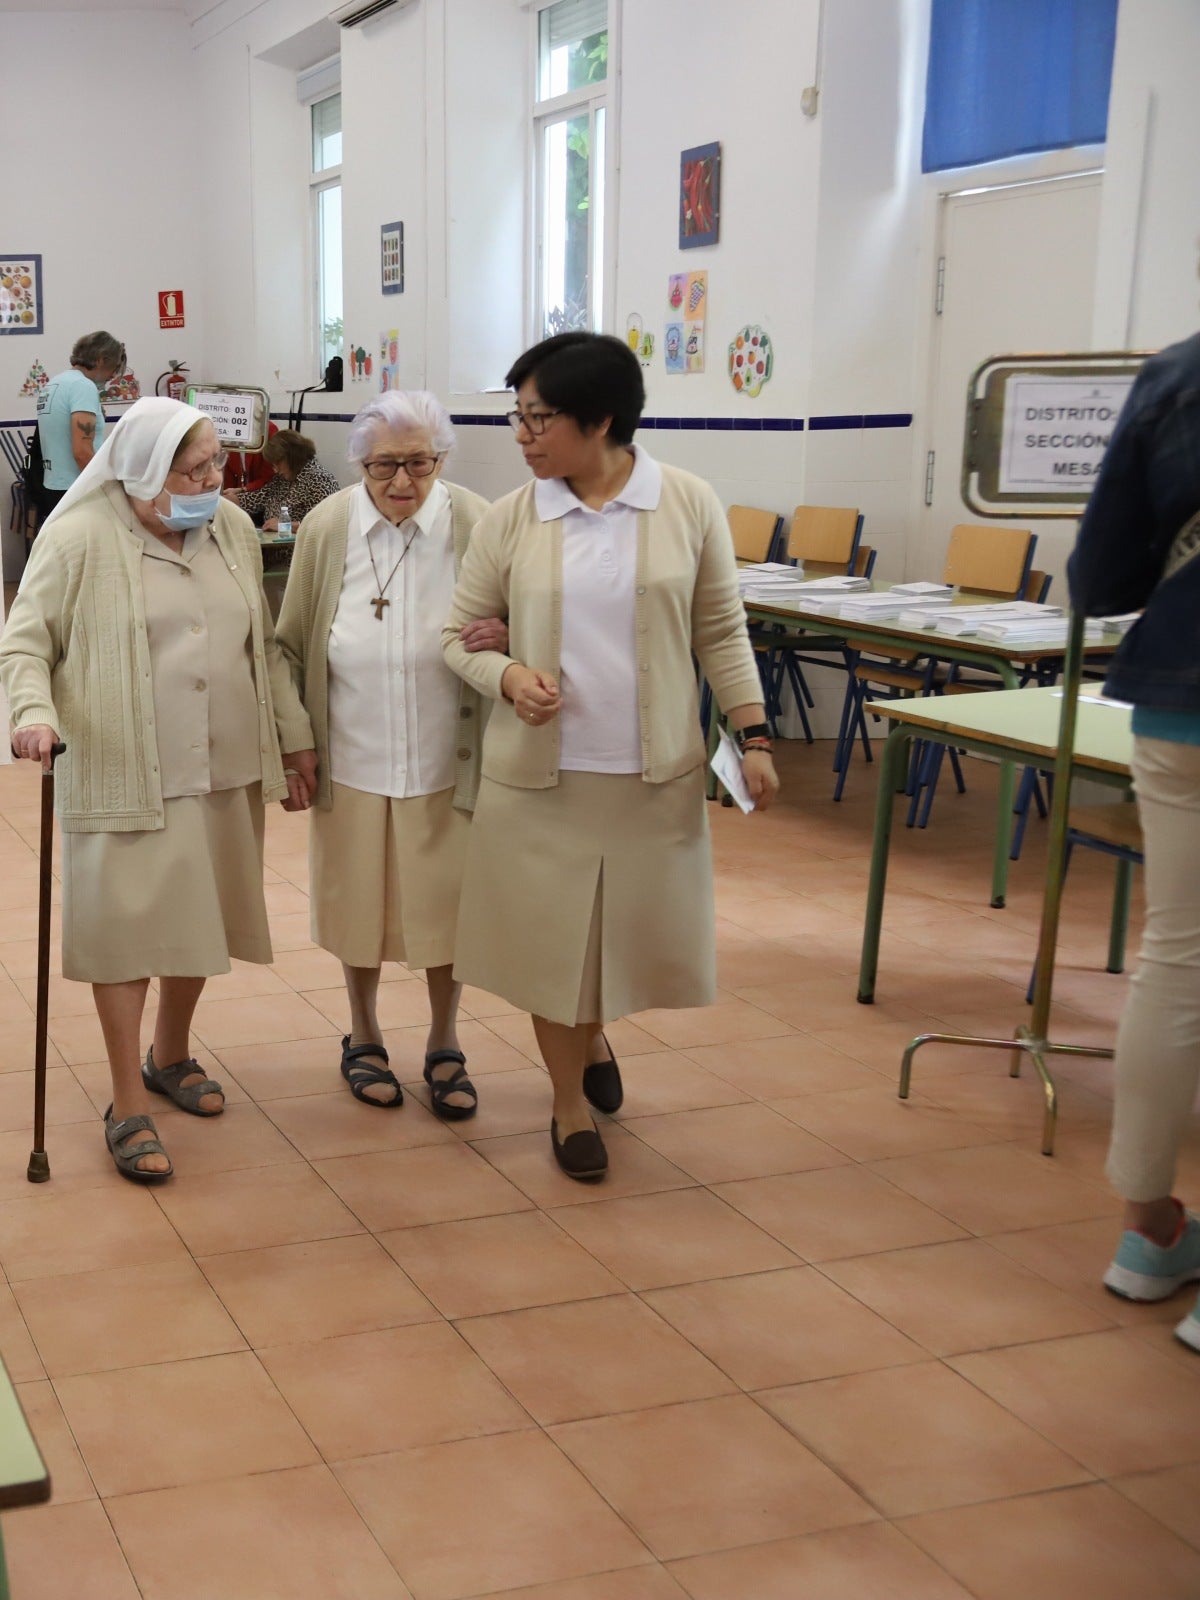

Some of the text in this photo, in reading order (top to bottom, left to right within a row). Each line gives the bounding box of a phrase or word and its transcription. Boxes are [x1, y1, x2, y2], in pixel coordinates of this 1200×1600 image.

[235, 406, 246, 415] 03
[231, 417, 248, 426] 002
[235, 429, 242, 437] B
